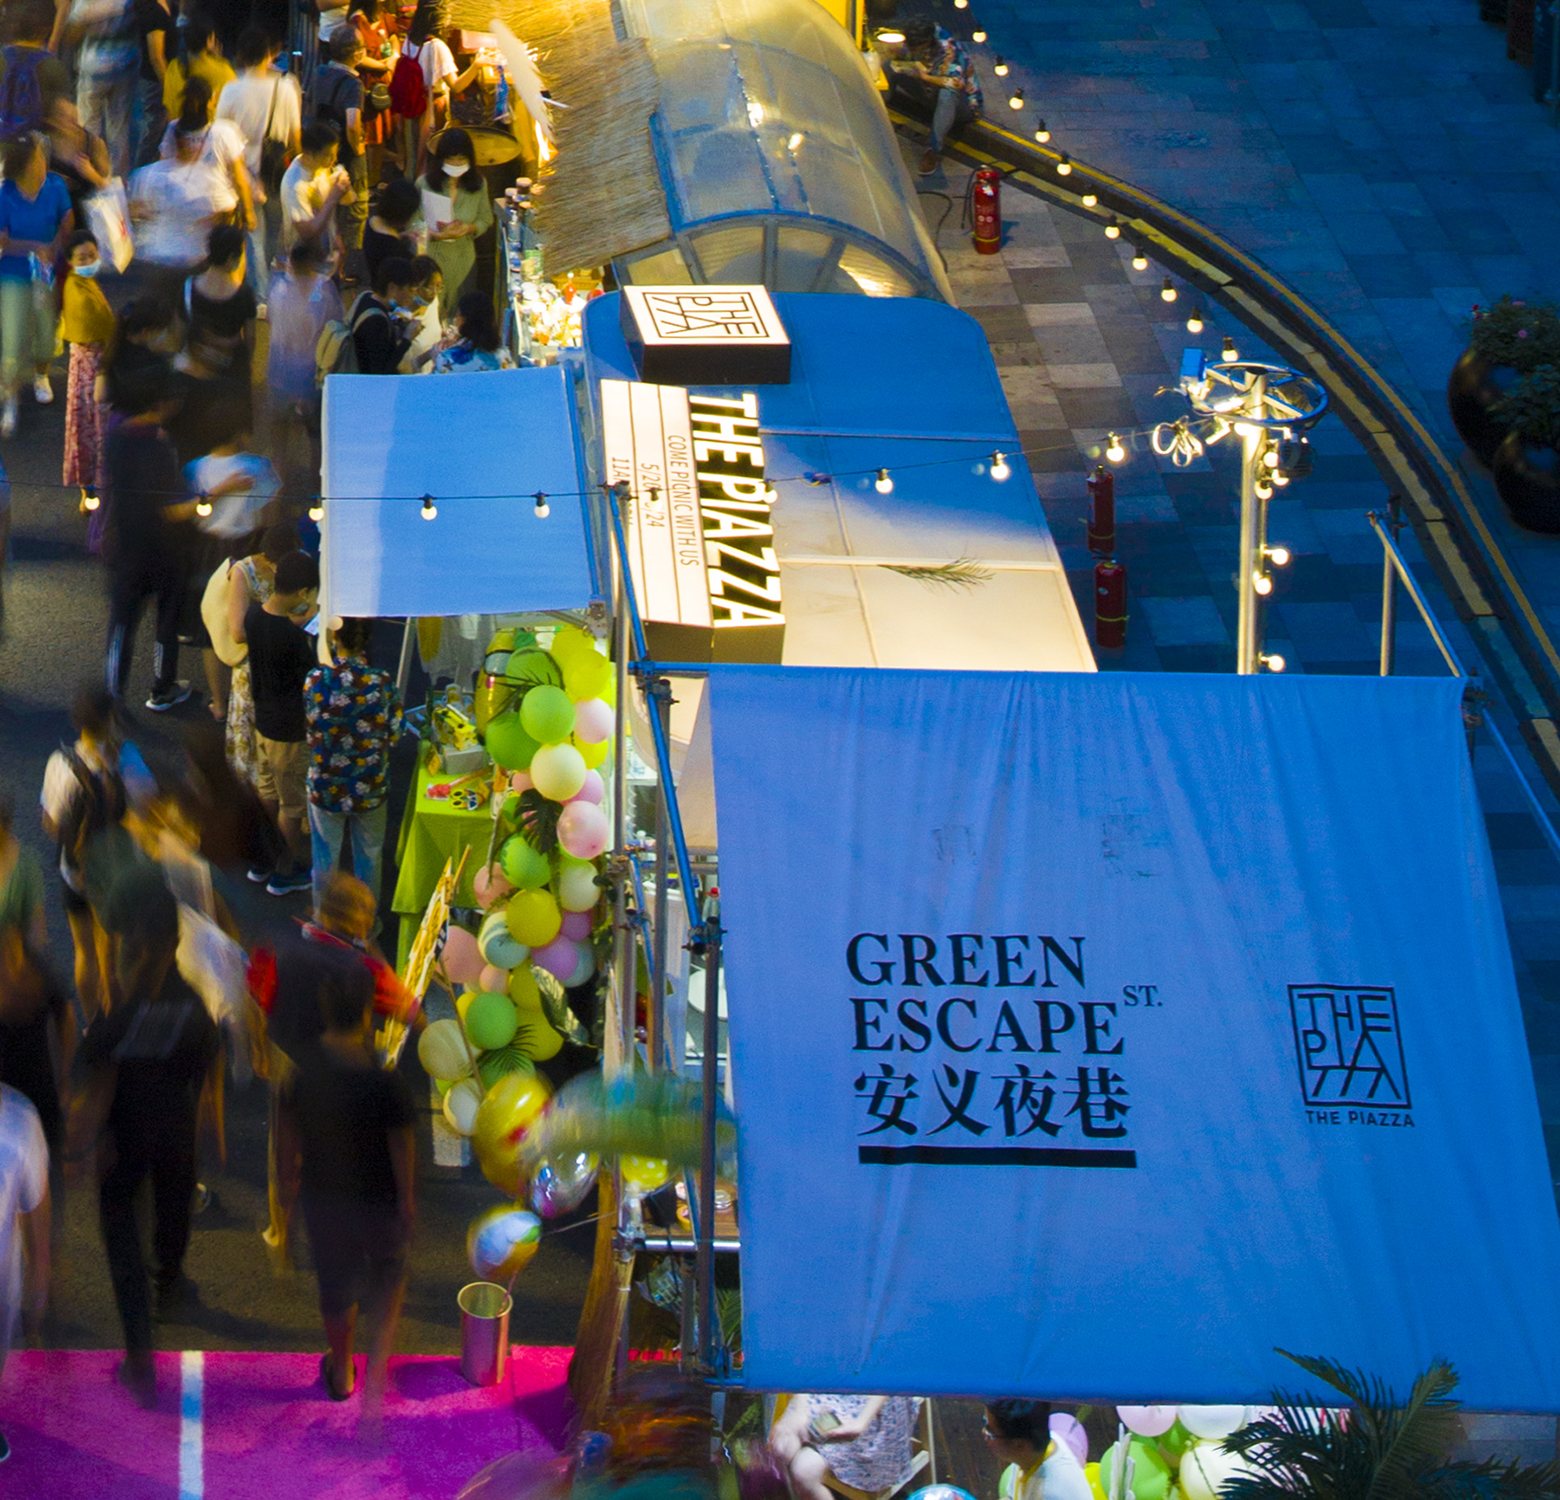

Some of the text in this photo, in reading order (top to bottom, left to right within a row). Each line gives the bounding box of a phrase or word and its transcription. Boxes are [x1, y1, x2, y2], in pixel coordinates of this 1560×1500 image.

[667, 435, 700, 566] COME PICNIC WITH US
[690, 392, 787, 629] THE PIAZZA
[845, 931, 1087, 989] GREEN
[848, 984, 1164, 1056] ESCAPE ST.
[852, 1062, 1132, 1139] 安义夜巷
[1305, 1109, 1416, 1129] THE PIAZZA
